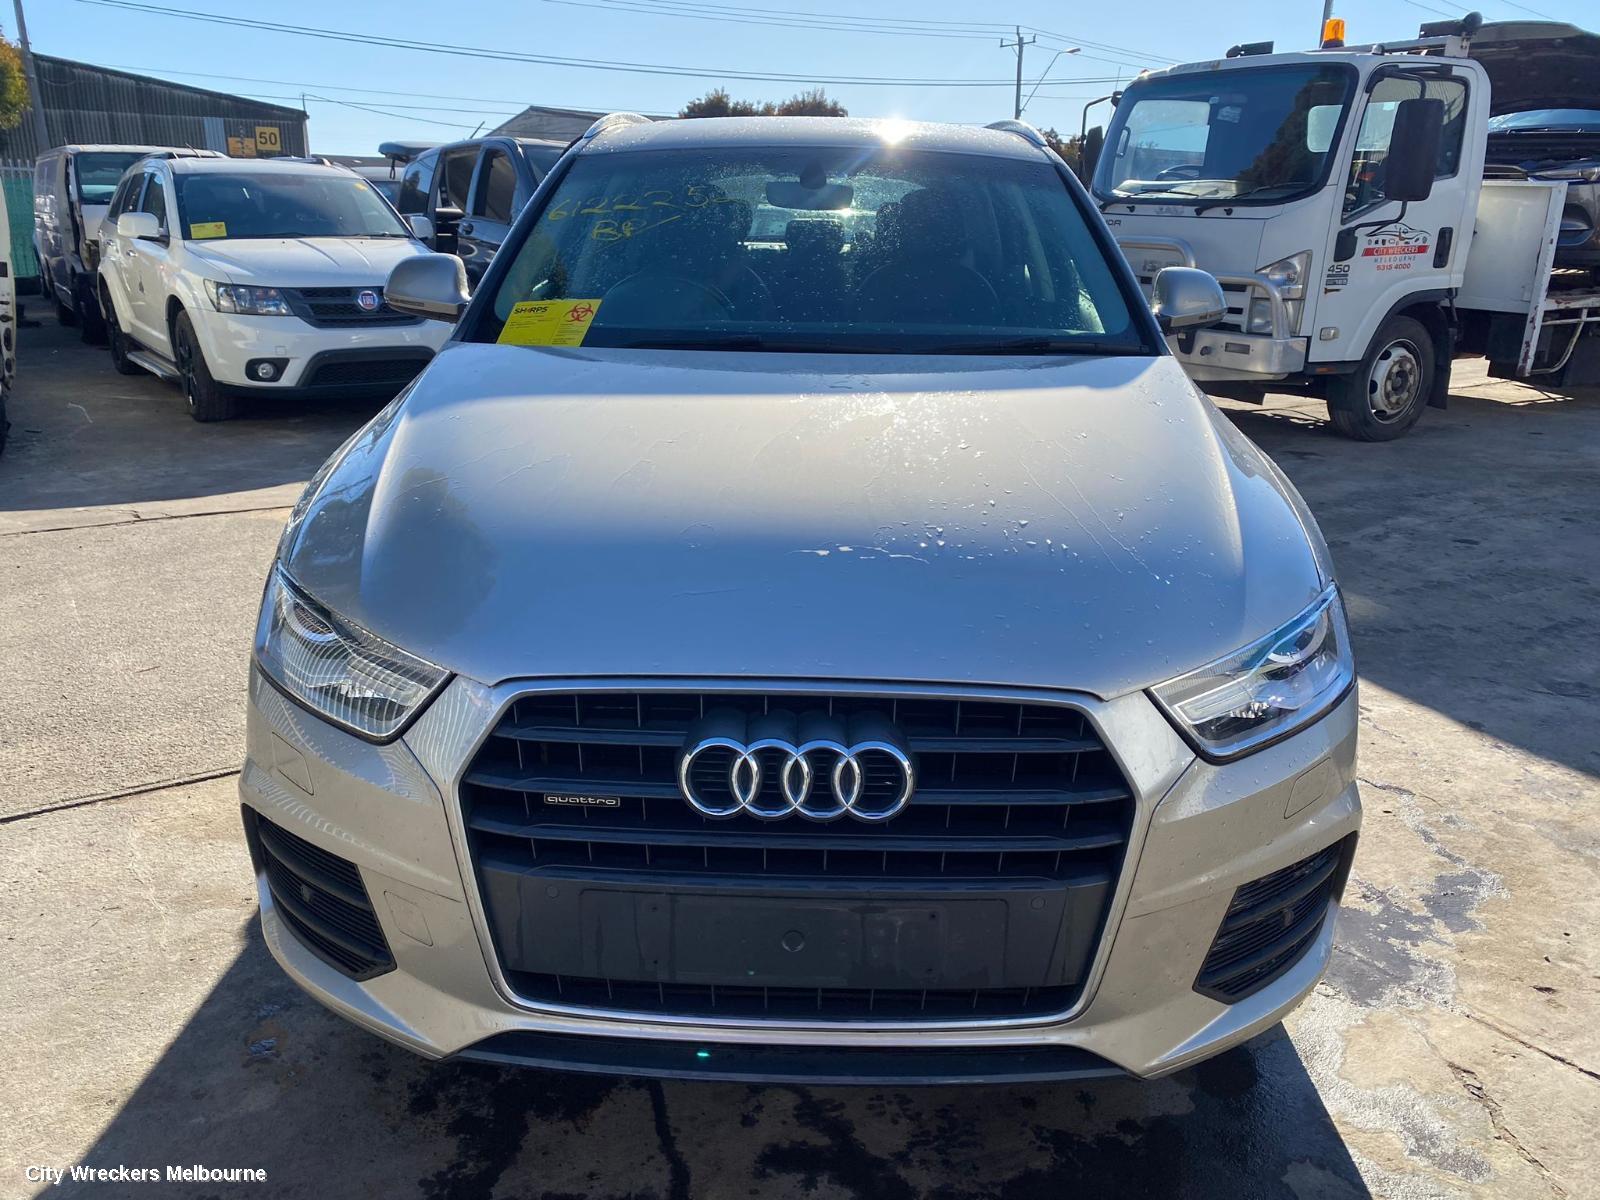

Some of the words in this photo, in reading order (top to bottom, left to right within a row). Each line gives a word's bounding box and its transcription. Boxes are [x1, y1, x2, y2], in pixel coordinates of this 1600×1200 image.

[259, 131, 278, 146] 50
[1373, 247, 1387, 256] CITY
[1388, 245, 1419, 254] WRECKERS
[1327, 264, 1350, 273] 450
[1376, 263, 1393, 271] 5315
[547, 796, 616, 805] quattro
